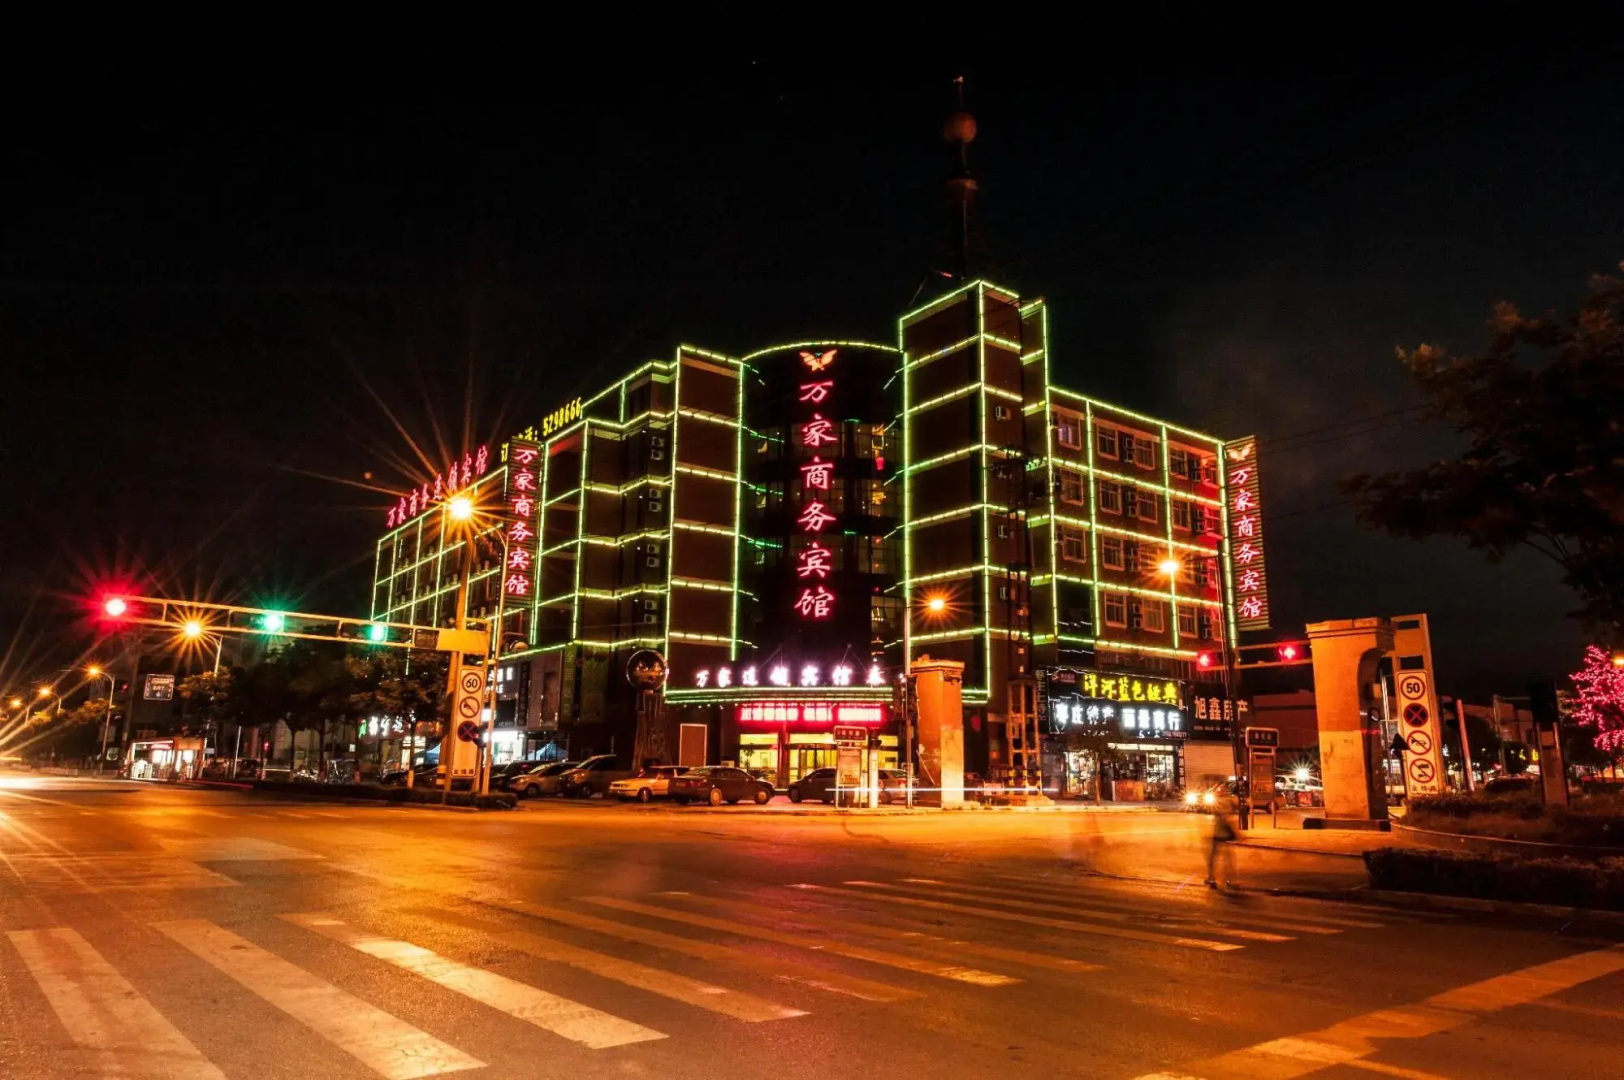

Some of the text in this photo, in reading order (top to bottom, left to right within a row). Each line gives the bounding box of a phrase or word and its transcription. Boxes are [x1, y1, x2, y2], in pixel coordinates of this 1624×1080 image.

[543, 397, 581, 436] 5298666
[505, 448, 538, 595] 万家商务宾馆
[794, 381, 837, 617] 万家商务宾馆
[1230, 467, 1262, 618] 万家商务宾馆
[466, 679, 478, 688] 60
[1406, 682, 1420, 694] 50
